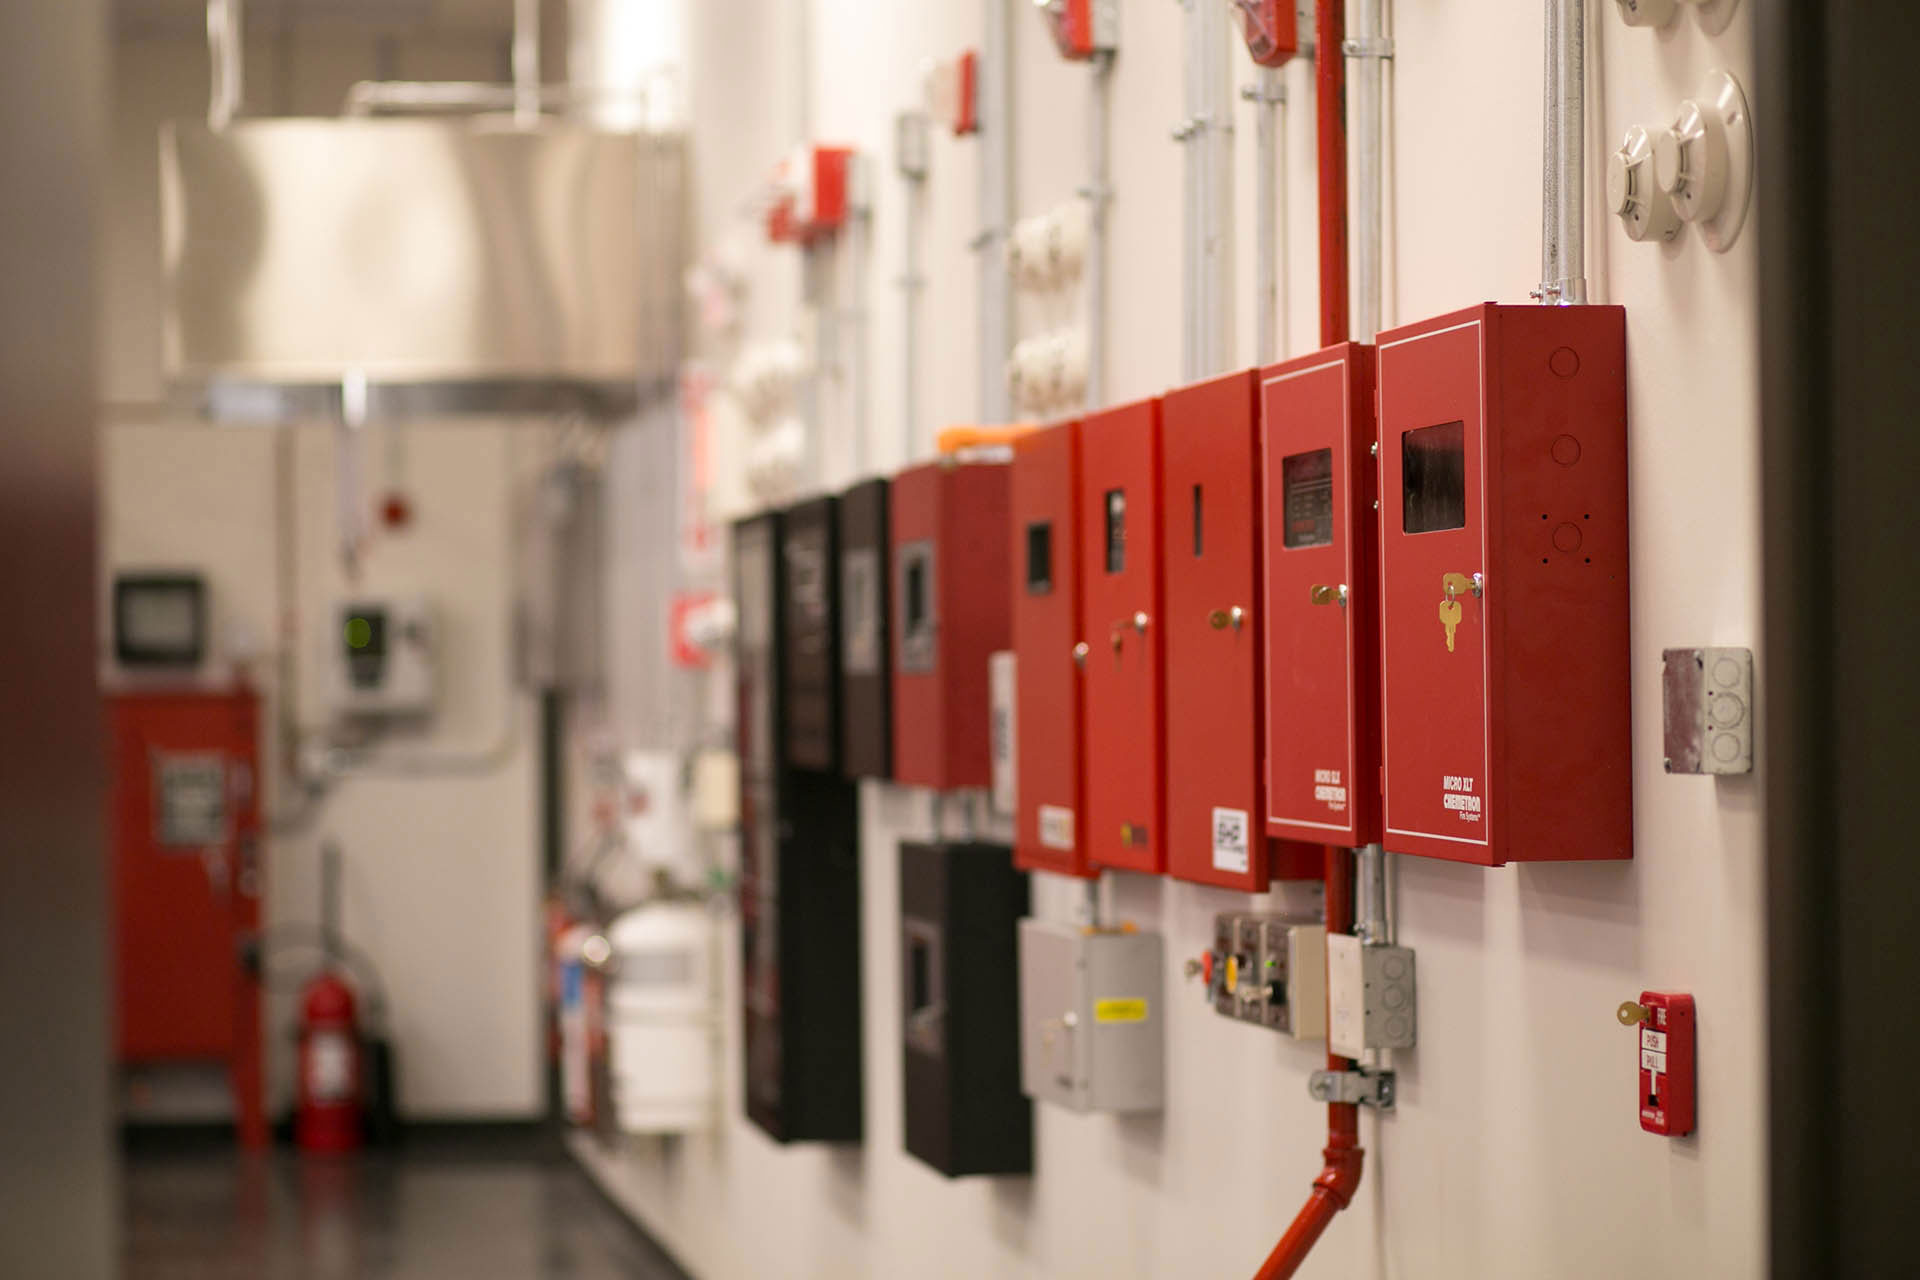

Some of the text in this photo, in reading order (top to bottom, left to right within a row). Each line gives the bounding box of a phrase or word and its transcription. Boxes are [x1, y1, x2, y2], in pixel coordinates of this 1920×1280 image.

[1443, 776, 1473, 792] MICRO XLT
[1443, 793, 1481, 812] CHEMETRON
